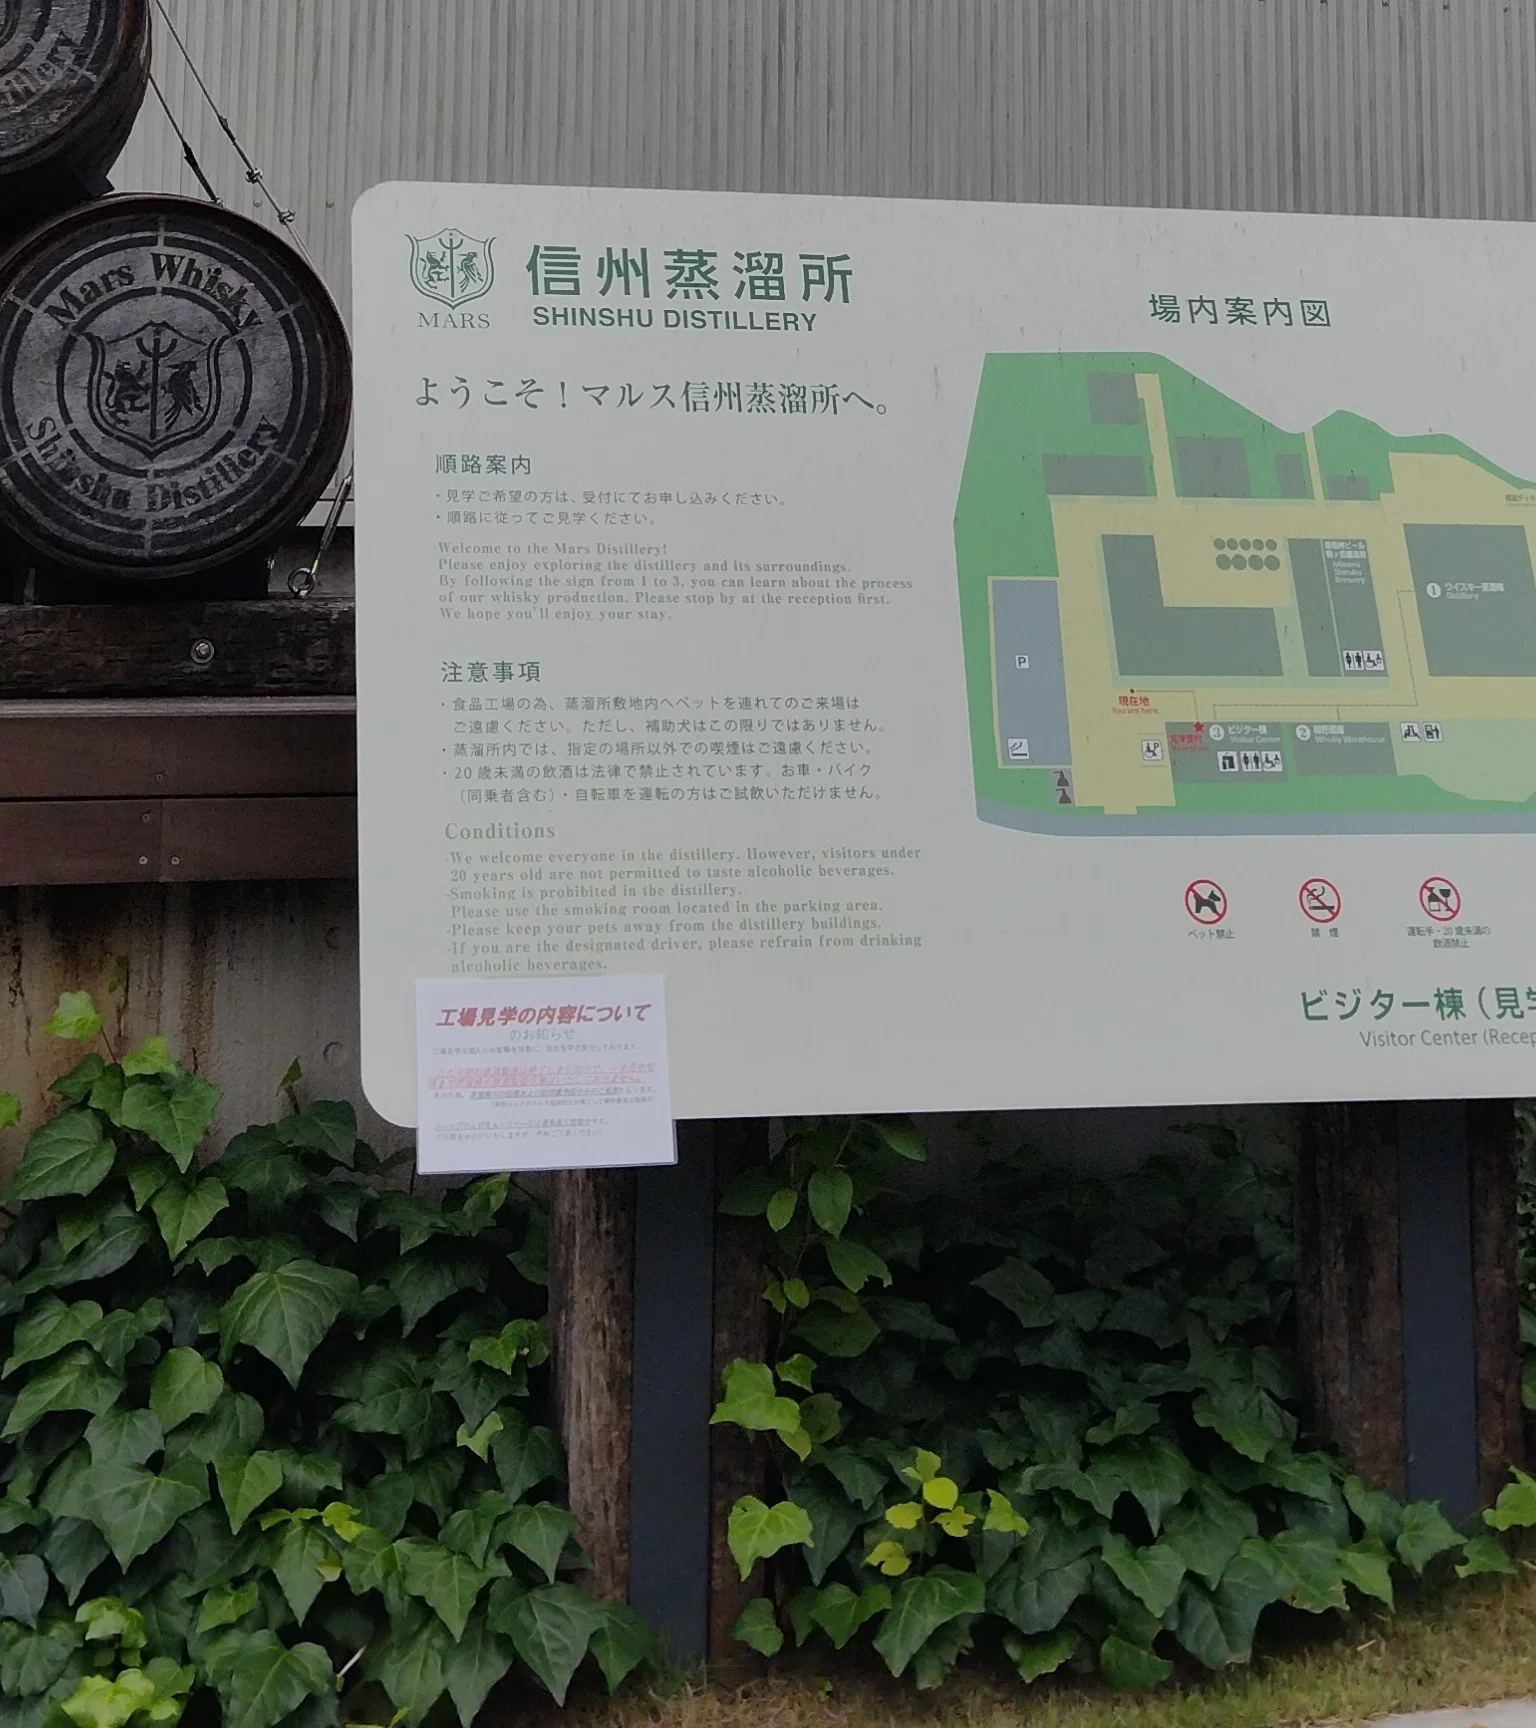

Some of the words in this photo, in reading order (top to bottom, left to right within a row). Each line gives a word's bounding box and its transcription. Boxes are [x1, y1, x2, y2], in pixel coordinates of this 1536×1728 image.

[525, 243, 854, 304] 信州蒸溜所
[43, 265, 135, 330] Mars
[150, 252, 263, 330] Whisky
[417, 311, 491, 329] MARS
[532, 306, 654, 329] SHINSHU
[664, 309, 817, 332] DISTILLERY
[1149, 293, 1331, 328] 場内案内図
[25, 416, 130, 510] Shinshu
[145, 413, 282, 512] Distillery
[435, 453, 531, 476] 順路案内
[438, 541, 502, 554] Welcome
[507, 542, 521, 554] to
[527, 542, 549, 554] the
[554, 542, 591, 555] Mars
[596, 543, 667, 557] Distillery!
[438, 558, 484, 571] Please
[489, 561, 527, 573] enjoy
[533, 559, 603, 574] exploring
[607, 559, 629, 571] the
[633, 559, 696, 574] distillery
[703, 559, 728, 572] and
[733, 559, 751, 572] its
[755, 560, 852, 575] surroundings.
[439, 575, 458, 589] By
[464, 575, 533, 589] following
[538, 575, 559, 587] the
[565, 576, 594, 590] sign
[600, 576, 634, 587] from
[653, 576, 667, 588] to
[672, 576, 685, 590] 3,
[691, 579, 715, 590] you
[720, 579, 744, 588] can
[750, 576, 786, 588] learn
[791, 577, 829, 588] about
[835, 577, 856, 588] the
[862, 579, 913, 591] process
[438, 591, 453, 603] of
[459, 594, 483, 604] our
[491, 591, 539, 606] whisky
[547, 592, 630, 606] production.
[635, 592, 680, 604] Please
[685, 592, 714, 607] stop
[719, 592, 734, 607] by
[742, 592, 755, 604] at
[761, 592, 782, 604] the
[787, 593, 852, 607] reception
[857, 593, 891, 605] first.
[440, 607, 461, 620] We
[467, 607, 501, 622] hope
[507, 607, 549, 622] you'll
[555, 610, 591, 623] enjoy
[599, 611, 632, 623] your
[637, 608, 673, 623] stay.
[440, 660, 542, 684] 注意事項
[1117, 695, 1150, 707] 現在地
[444, 822, 556, 840] Conditions
[479, 850, 543, 863] welcome
[548, 852, 616, 865] everyone
[621, 849, 635, 862] in
[641, 849, 664, 861] the
[669, 848, 741, 863] distillery.
[745, 847, 816, 862] However,
[822, 847, 876, 859] visitors
[881, 846, 922, 859] under
[450, 869, 467, 881] 20
[472, 871, 514, 883] years
[519, 868, 543, 880] old
[548, 870, 574, 880] are
[579, 867, 603, 879] not
[609, 866, 681, 881] permitted
[686, 865, 701, 878] to
[706, 865, 742, 877] taste
[747, 864, 812, 876] alcoholic
[818, 863, 894, 878] beverages.
[521, 886, 534, 898] is
[540, 885, 617, 900] prohibited
[622, 885, 637, 897] in
[642, 884, 665, 896] the
[670, 884, 743, 898] distillery.
[451, 905, 500, 917] Please
[505, 907, 530, 916] use
[535, 903, 558, 916] the
[564, 903, 627, 918] smoking
[632, 905, 671, 914] room
[676, 901, 731, 913] located
[736, 900, 750, 913] in
[755, 900, 778, 912] the
[783, 899, 841, 914] parking
[845, 901, 883, 911] area.
[506, 922, 541, 937] keep
[546, 924, 582, 936] your
[587, 920, 618, 935] pets
[623, 922, 661, 935] away
[668, 919, 705, 932] from
[711, 918, 734, 931] the
[739, 917, 806, 933] distillery
[811, 916, 883, 932] buildings.
[1188, 929, 1235, 940] ペット禁止
[472, 943, 499, 955] you
[505, 943, 531, 952] are
[536, 939, 560, 952] the
[565, 938, 645, 953] designated
[650, 937, 703, 952] driver,
[708, 936, 754, 951] please
[759, 935, 813, 948] refrain
[819, 934, 854, 947] from
[859, 934, 922, 949] drinking
[451, 959, 521, 972] alcoholic
[527, 958, 608, 972] beverages.
[436, 1003, 652, 1028] 工場見学の内容について
[509, 1028, 576, 1041] のお知らせ
[1359, 1029, 1416, 1049] Visitor
[1420, 1029, 1478, 1048] Center
